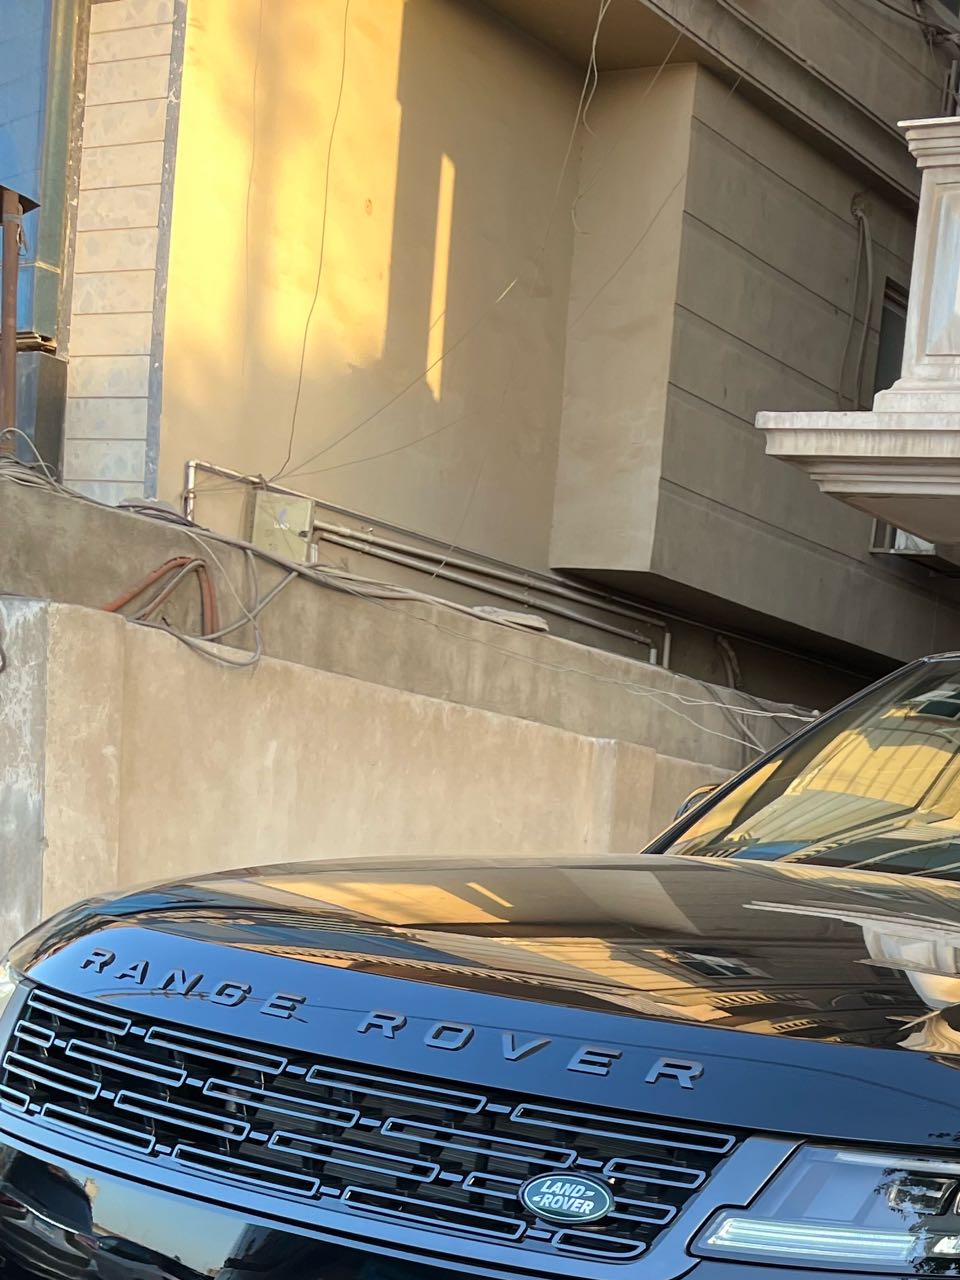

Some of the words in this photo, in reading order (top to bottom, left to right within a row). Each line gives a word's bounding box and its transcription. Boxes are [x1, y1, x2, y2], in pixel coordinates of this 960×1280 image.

[80, 947, 306, 1019] RANGE
[356, 1010, 705, 1090] ROVER
[540, 1180, 586, 1198] LAND
[539, 1194, 595, 1215] ROVER
